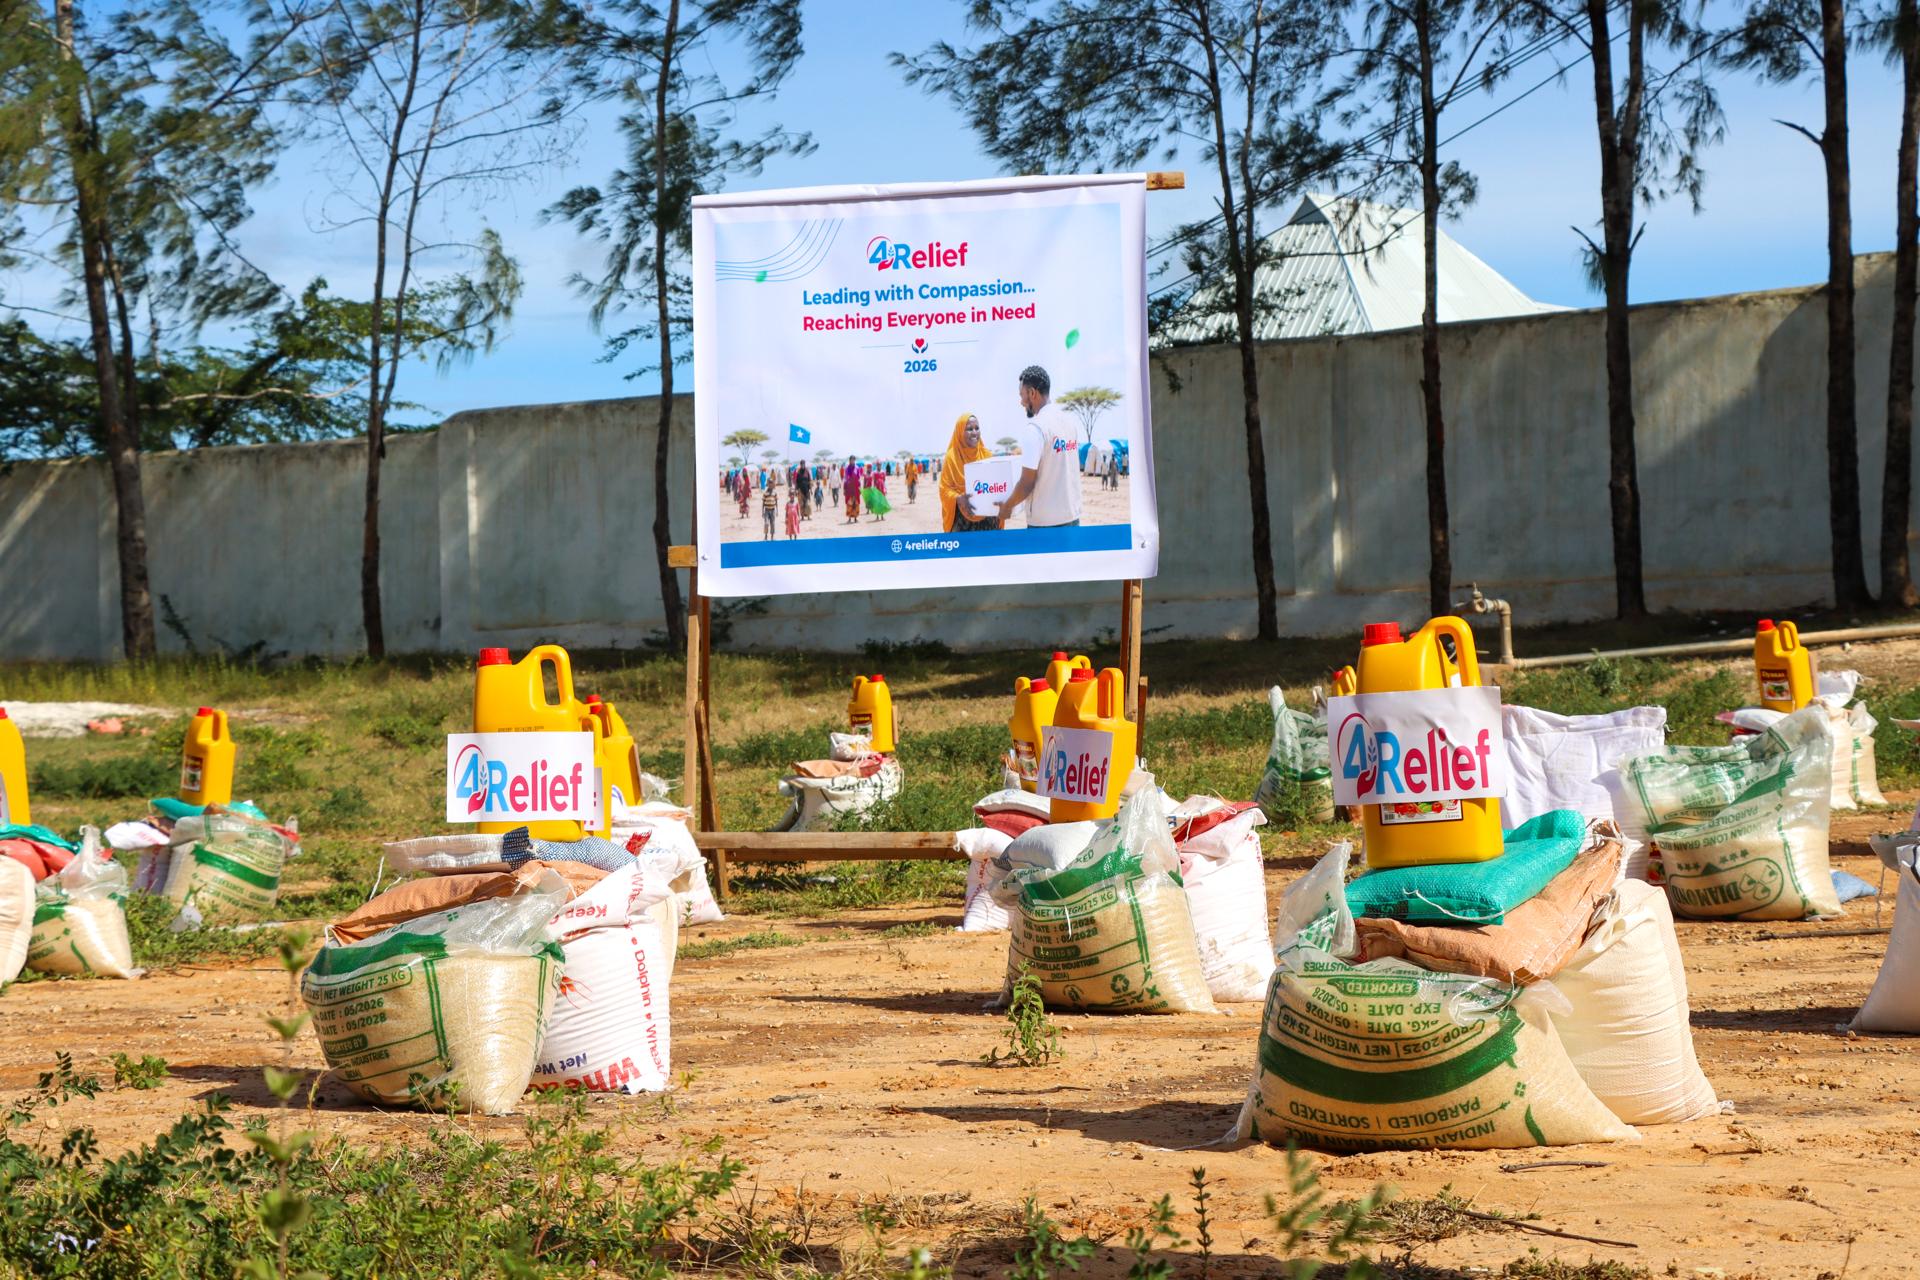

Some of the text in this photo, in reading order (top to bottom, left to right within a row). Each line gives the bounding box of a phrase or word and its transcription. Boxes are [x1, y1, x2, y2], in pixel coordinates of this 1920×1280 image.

[867, 237, 968, 270] 4Relief
[802, 279, 1036, 306] Leading with Compassion...
[803, 303, 1036, 332] Reaching Everyone in Need
[903, 359, 937, 373] 2026
[973, 480, 1007, 494] 4Relief
[904, 539, 960, 552] 4relief.ngo
[1340, 719, 1490, 795] 4Relief
[1044, 746, 1108, 797] 4Relief
[455, 750, 582, 813] 4Relief
[1673, 840, 1700, 850] GRAIN
[1702, 833, 1728, 847] LONG
[1671, 881, 1743, 907] DIAMOND
[564, 903, 608, 920] Keep
[1034, 908, 1050, 917] NET
[1101, 891, 1114, 901] KG
[324, 987, 338, 999] NET
[338, 979, 375, 997] WEIGHT
[377, 975, 388, 986] 25
[391, 969, 406, 983] KG
[634, 949, 652, 1008] Dolphin
[1345, 982, 1412, 994] EXPORTED
[343, 997, 384, 1016] 05/2026
[1305, 1002, 1351, 1029] 05/2026
[1368, 1003, 1404, 1016] DATE
[1410, 1002, 1441, 1014] EXP.
[345, 1013, 387, 1032] 05/2028
[1298, 1022, 1311, 1036] 25
[1368, 1022, 1401, 1034] DATE
[1312, 1030, 1361, 1054] WEIGHT
[1365, 1045, 1392, 1056] NET
[1403, 1036, 1440, 1055] 2025
[559, 1052, 588, 1072] Net
[1289, 1097, 1481, 1129] PARBOILED SORTEXED
[1433, 1119, 1496, 1145] INDIAN
